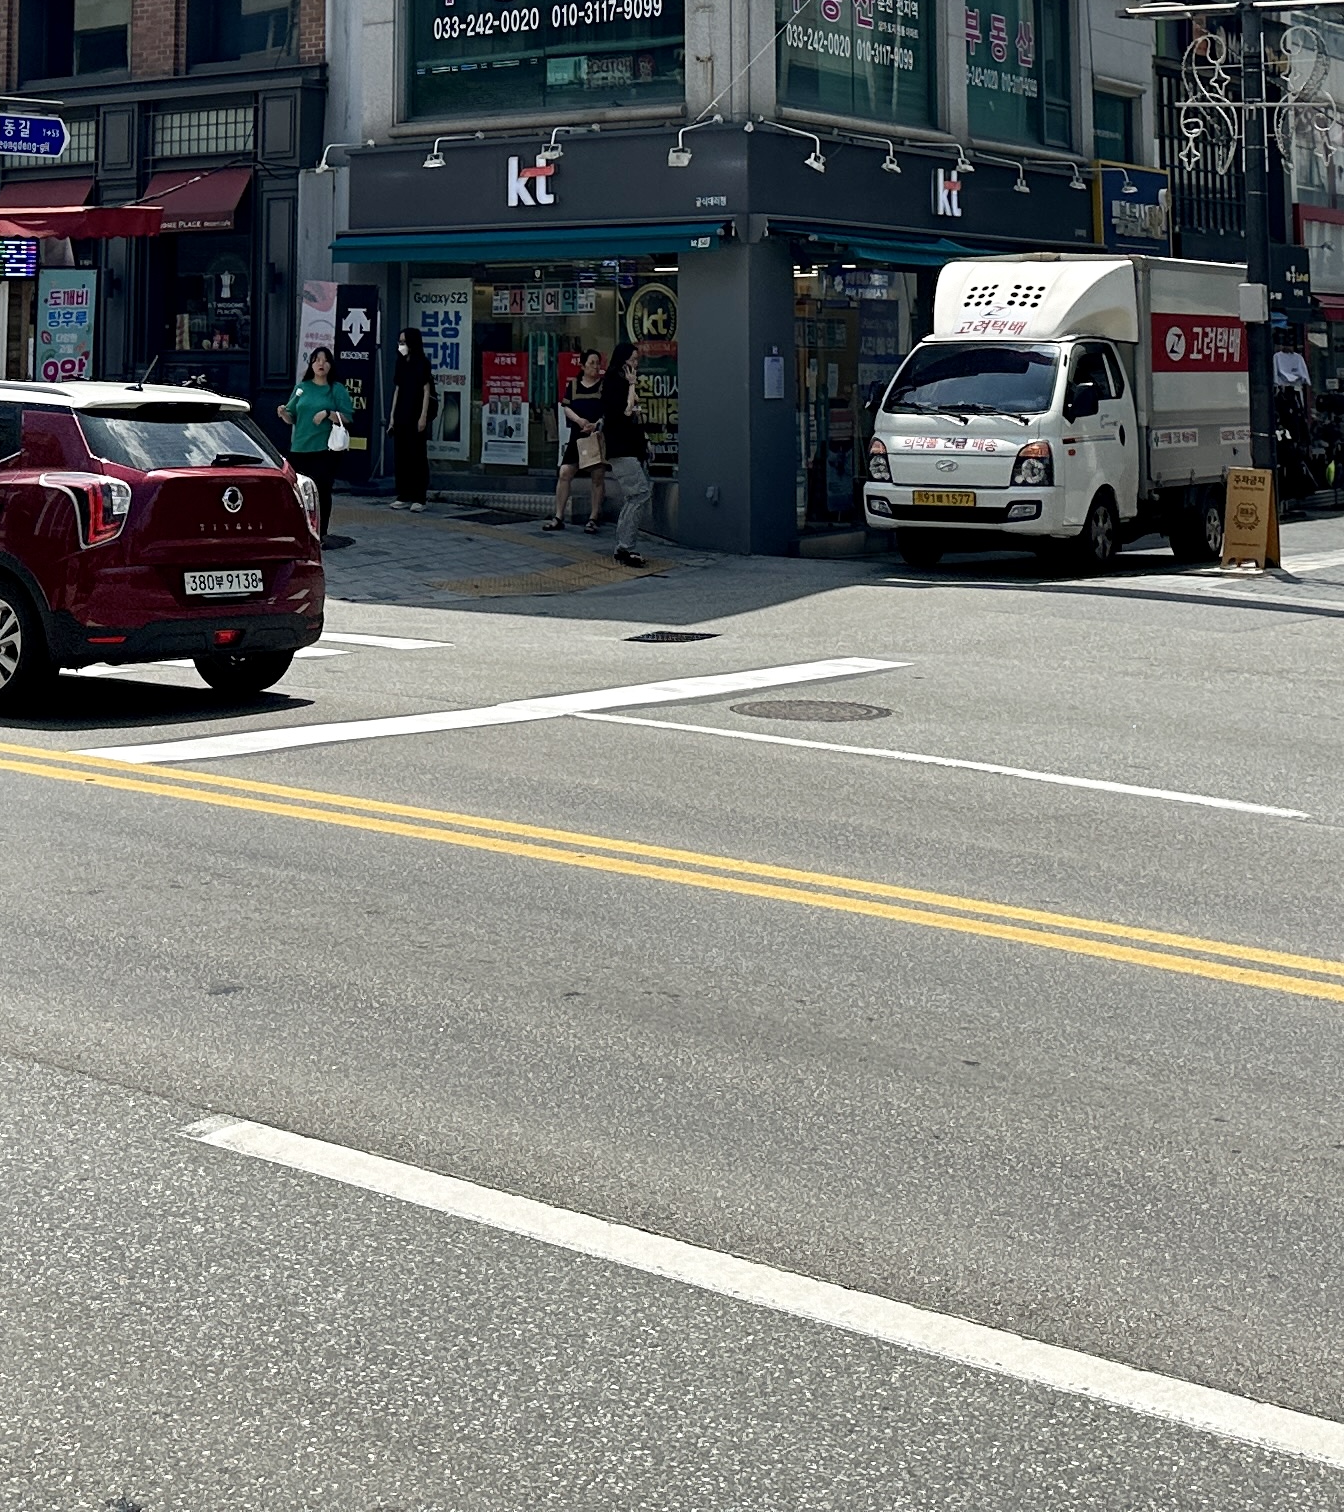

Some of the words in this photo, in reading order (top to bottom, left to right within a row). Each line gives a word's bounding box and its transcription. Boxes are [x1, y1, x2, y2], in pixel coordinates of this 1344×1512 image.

[433, 7, 540, 40] 033-242-0020
[786, 23, 851, 58] 033-242-0020
[857, 39, 914, 71] 010-3117-9099
[965, 6, 1035, 68] 부동산
[508, 155, 556, 208] kt
[936, 168, 962, 218] kt
[49, 289, 89, 308] 도깨비
[413, 291, 450, 306] Galaxy
[450, 292, 468, 304] S23
[47, 310, 89, 328] 탕후루
[421, 310, 462, 338] 보상
[642, 307, 667, 336] kt
[954, 319, 1028, 337] 고려택배
[1189, 326, 1242, 363] 고려택배
[971, 437, 998, 453] 배송
[1233, 474, 1266, 486] 주차금지
[946, 491, 971, 504] 1577
[190, 573, 224, 592] 380부
[226, 572, 259, 590] 9138
